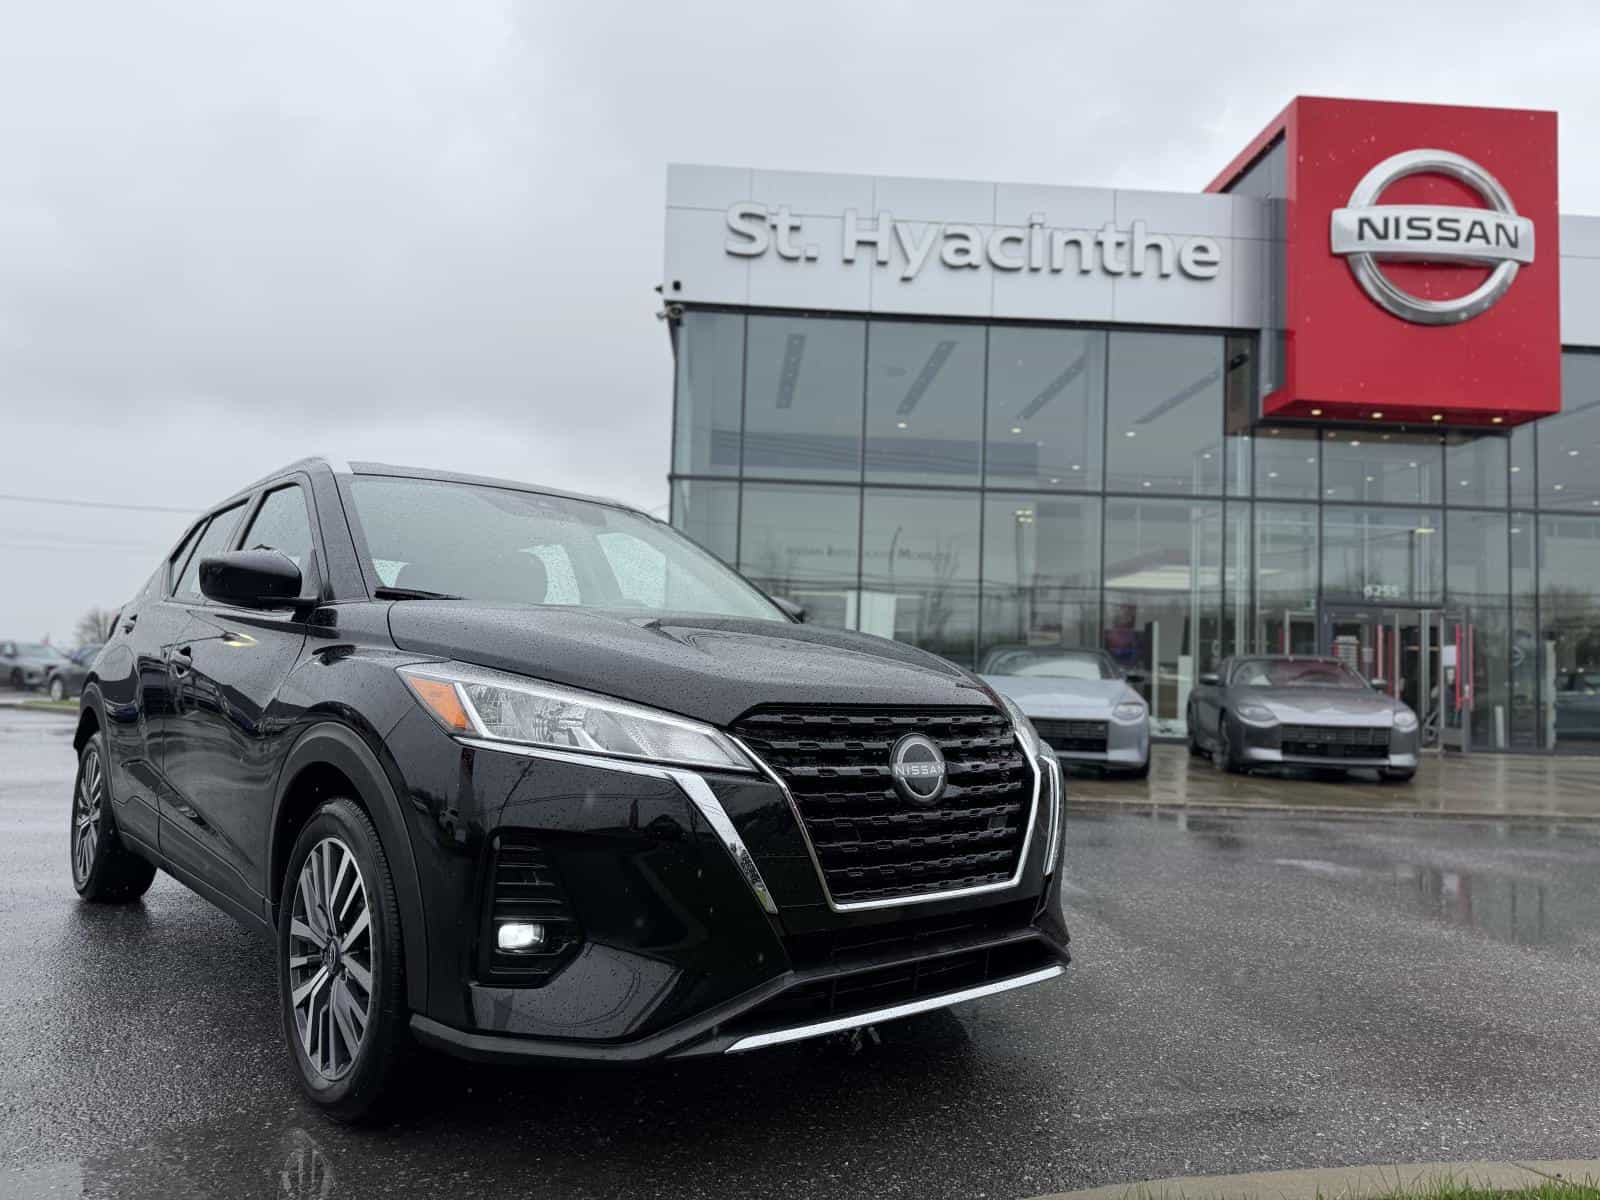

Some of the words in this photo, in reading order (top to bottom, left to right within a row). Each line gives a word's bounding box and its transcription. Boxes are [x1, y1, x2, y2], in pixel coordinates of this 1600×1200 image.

[725, 202, 817, 261] St.
[842, 208, 1221, 282] Hyacinthe
[1357, 216, 1519, 249] NISSAN
[895, 764, 945, 776] NISSAN
